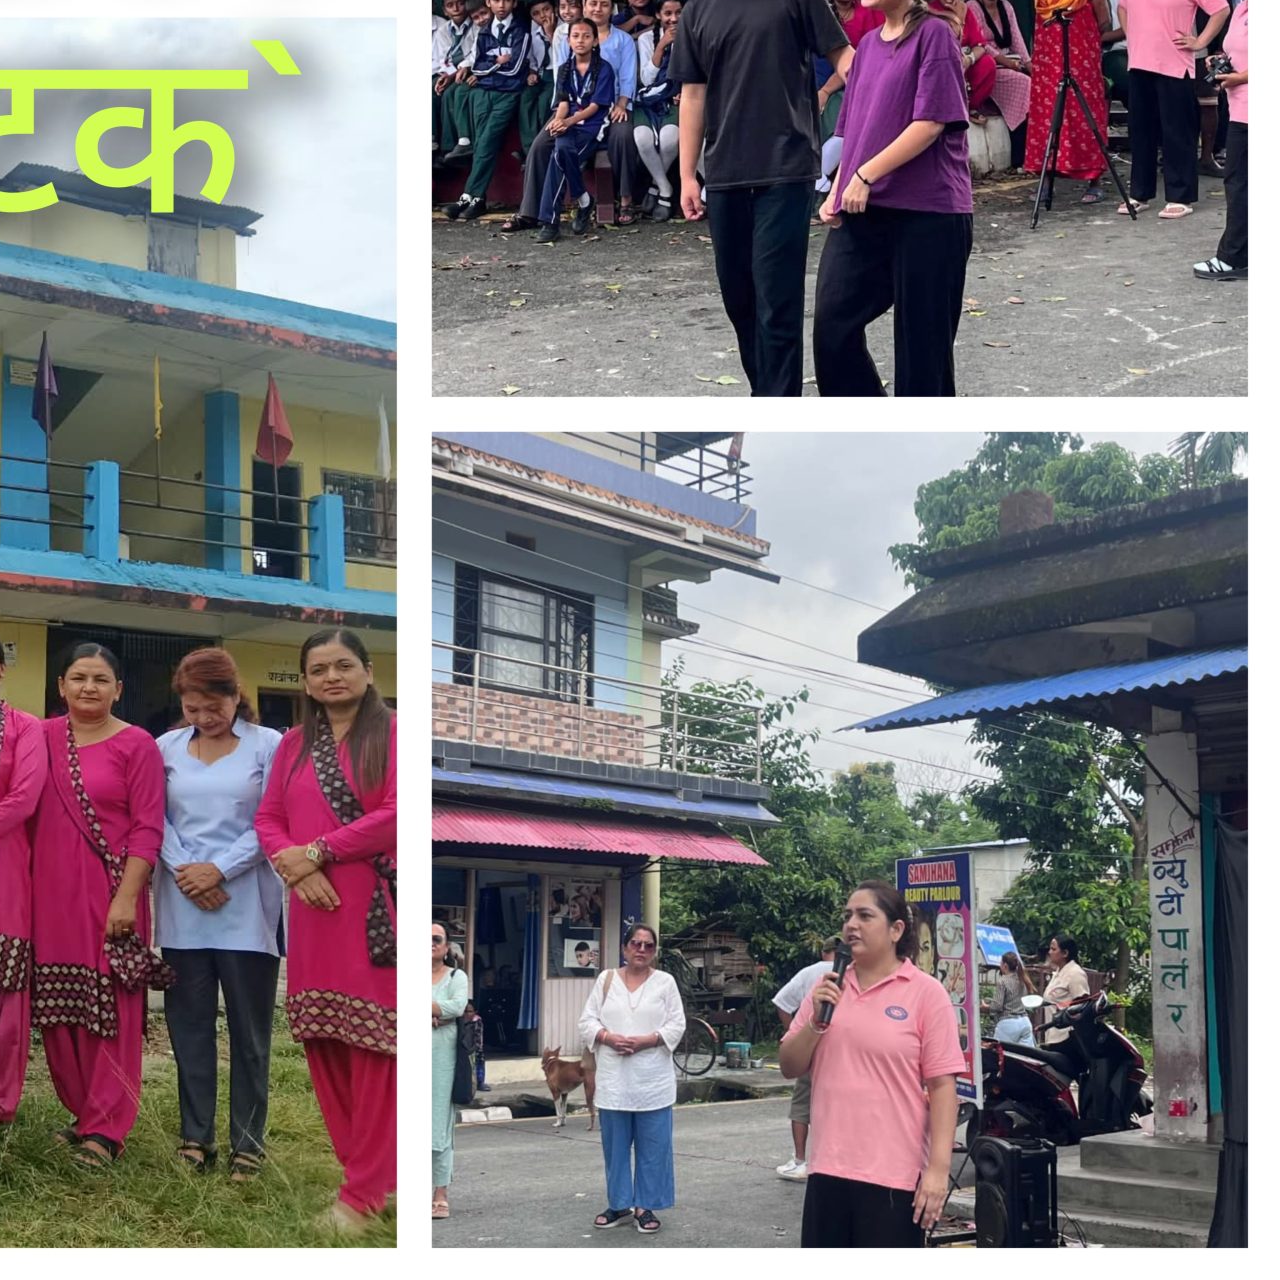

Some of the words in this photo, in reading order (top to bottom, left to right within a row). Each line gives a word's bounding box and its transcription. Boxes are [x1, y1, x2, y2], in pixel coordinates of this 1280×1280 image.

[908, 860, 957, 885] SAMJHANA
[904, 887, 928, 903] BEAUTY
[930, 885, 961, 901] PARLOUR
